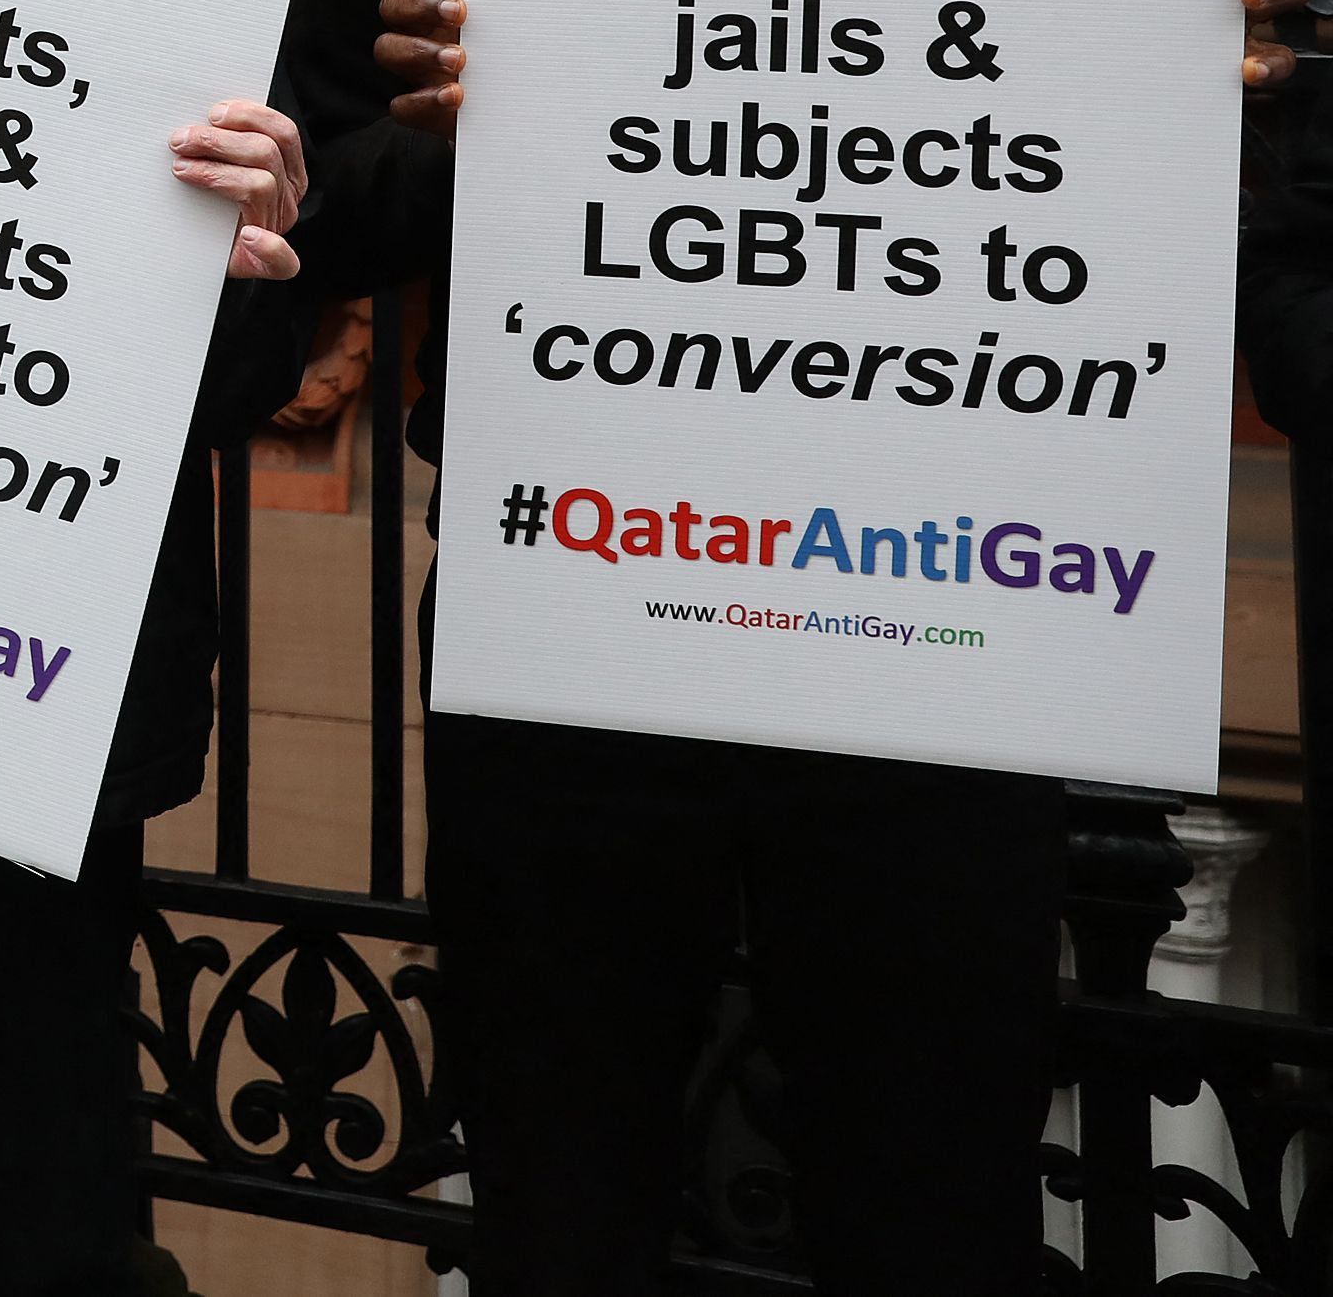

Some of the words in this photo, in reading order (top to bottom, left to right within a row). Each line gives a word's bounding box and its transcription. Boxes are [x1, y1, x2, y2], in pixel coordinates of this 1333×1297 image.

[926, 1, 1004, 82] &
[607, 102, 1063, 202] subjects
[584, 202, 941, 296] LGBTs
[981, 225, 1088, 304] to
[506, 303, 1166, 419] ‘conversion’
[500, 484, 1155, 614] #QatarAntiGay
[646, 602, 983, 647] www.QatarAntiGay.com
